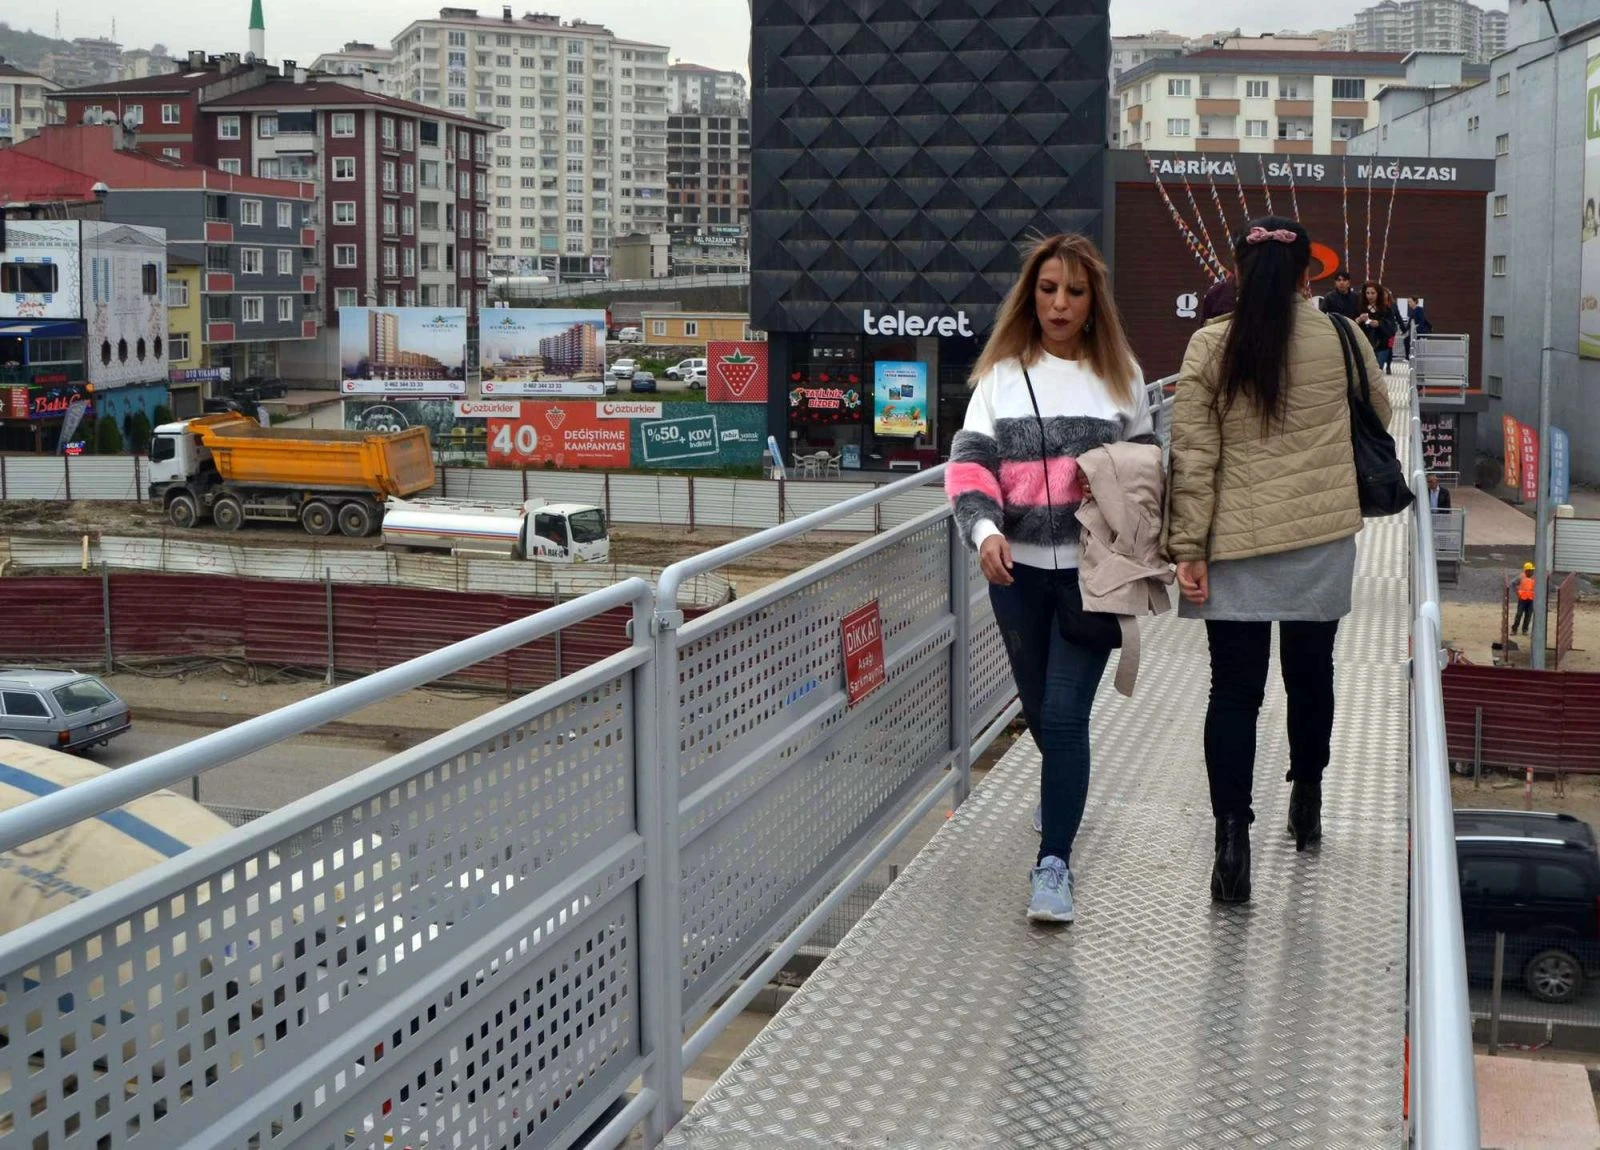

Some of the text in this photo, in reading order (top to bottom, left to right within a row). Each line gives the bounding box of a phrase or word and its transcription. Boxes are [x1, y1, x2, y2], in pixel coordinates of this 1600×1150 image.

[1150, 158, 1457, 182] FABRİKA SATIŞ MAĞAZASI
[863, 309, 974, 337] teleset
[563, 428, 625, 442] DEĞİŞTİRME
[688, 428, 713, 442] KDV
[563, 441, 626, 451] KAMPANYASI
[846, 617, 878, 652] DİKKAT
